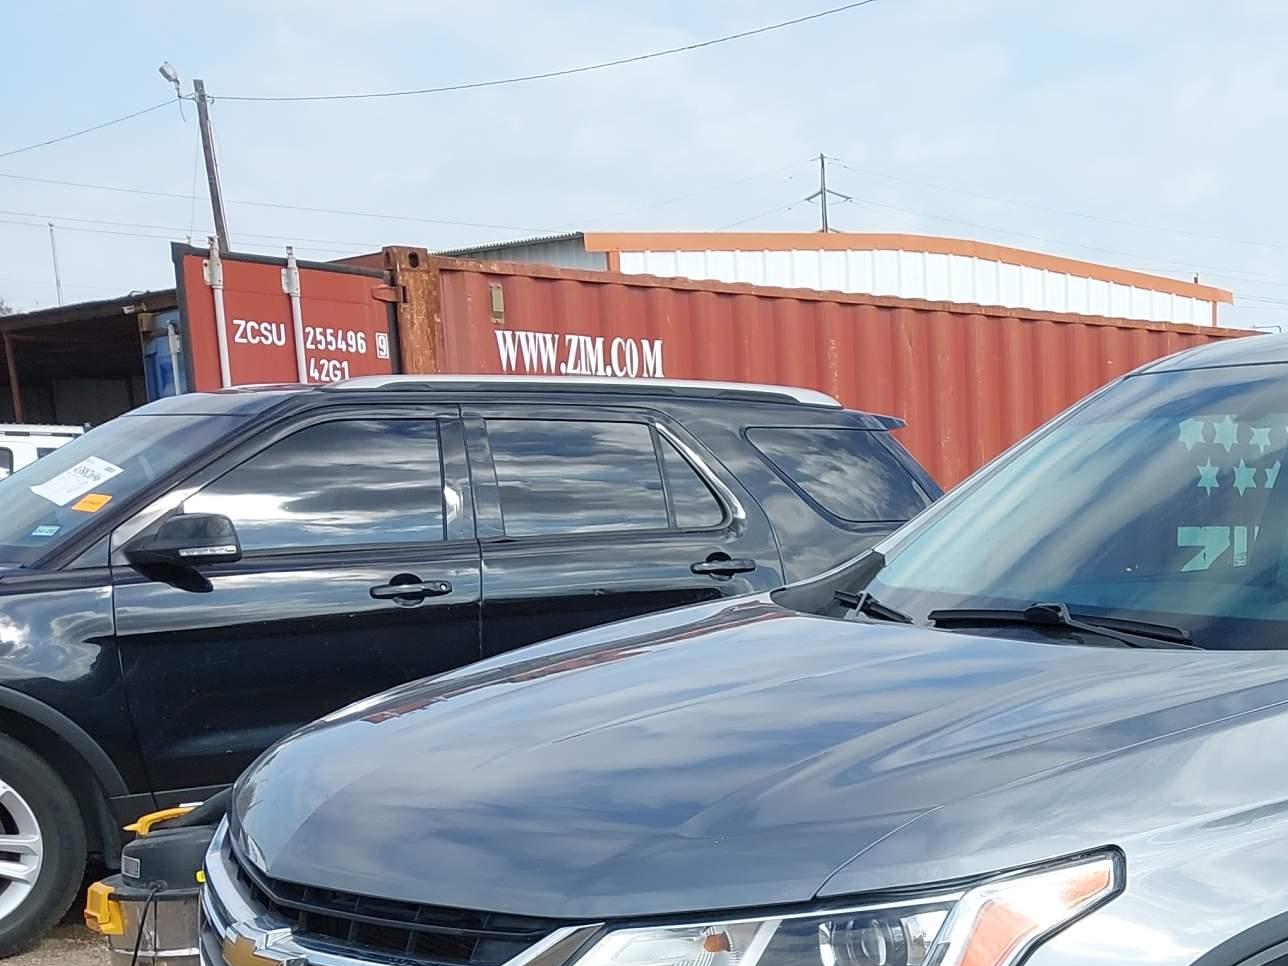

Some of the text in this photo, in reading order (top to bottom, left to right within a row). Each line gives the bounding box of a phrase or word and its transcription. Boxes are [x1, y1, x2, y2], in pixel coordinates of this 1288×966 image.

[232, 319, 387, 356] ZCSU 255496 9
[309, 357, 350, 382] 42G1
